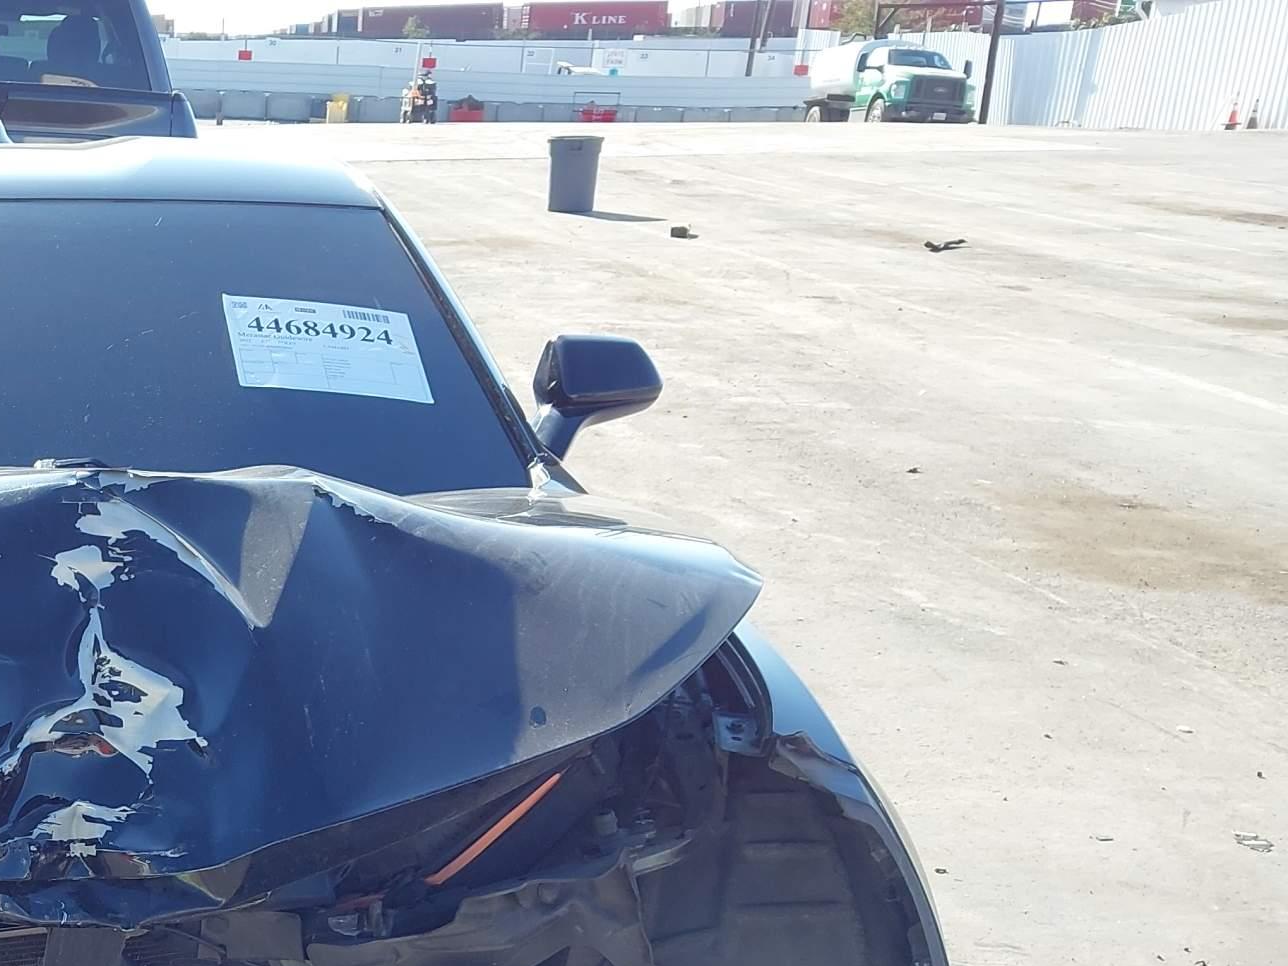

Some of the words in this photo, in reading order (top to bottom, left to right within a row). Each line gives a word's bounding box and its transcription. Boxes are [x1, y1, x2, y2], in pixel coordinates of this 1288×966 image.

[572, 12, 590, 25] K
[592, 15, 626, 24] LINE
[247, 316, 393, 345] 44684924
